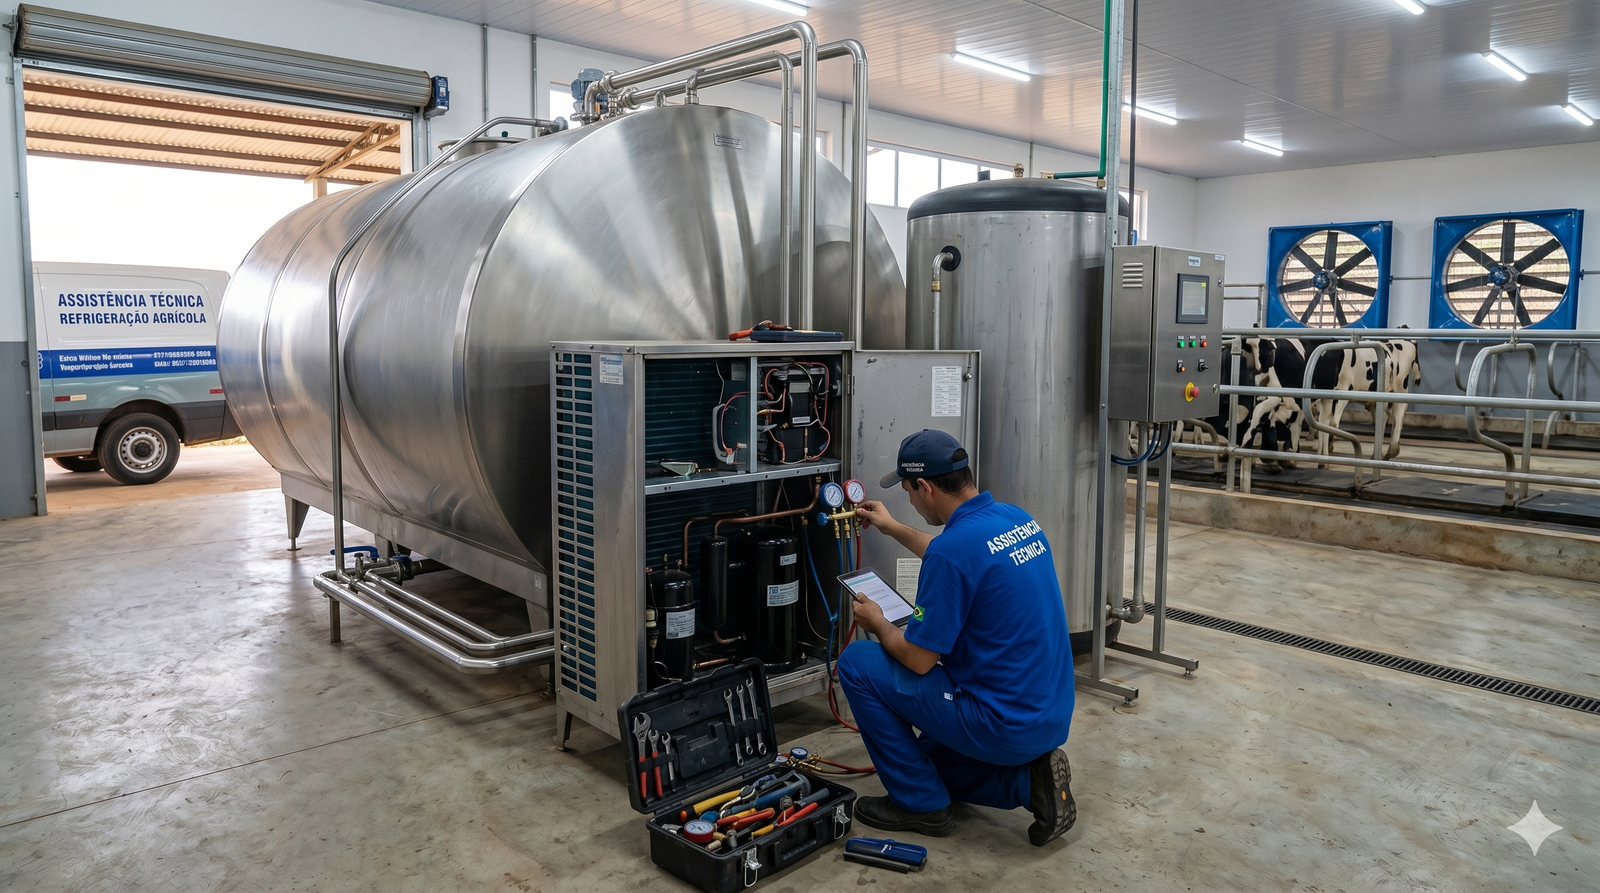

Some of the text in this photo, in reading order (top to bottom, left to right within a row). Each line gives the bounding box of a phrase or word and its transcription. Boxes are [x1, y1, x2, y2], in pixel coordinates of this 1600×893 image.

[58, 291, 204, 307] ASSISTÊNCIA TÉCNICA
[60, 310, 207, 326] REFRIGERAÇÃO AGRÍCOLA
[986, 519, 1042, 555] ASSISTÊNCIA
[1009, 539, 1047, 566] TÉCNICA
